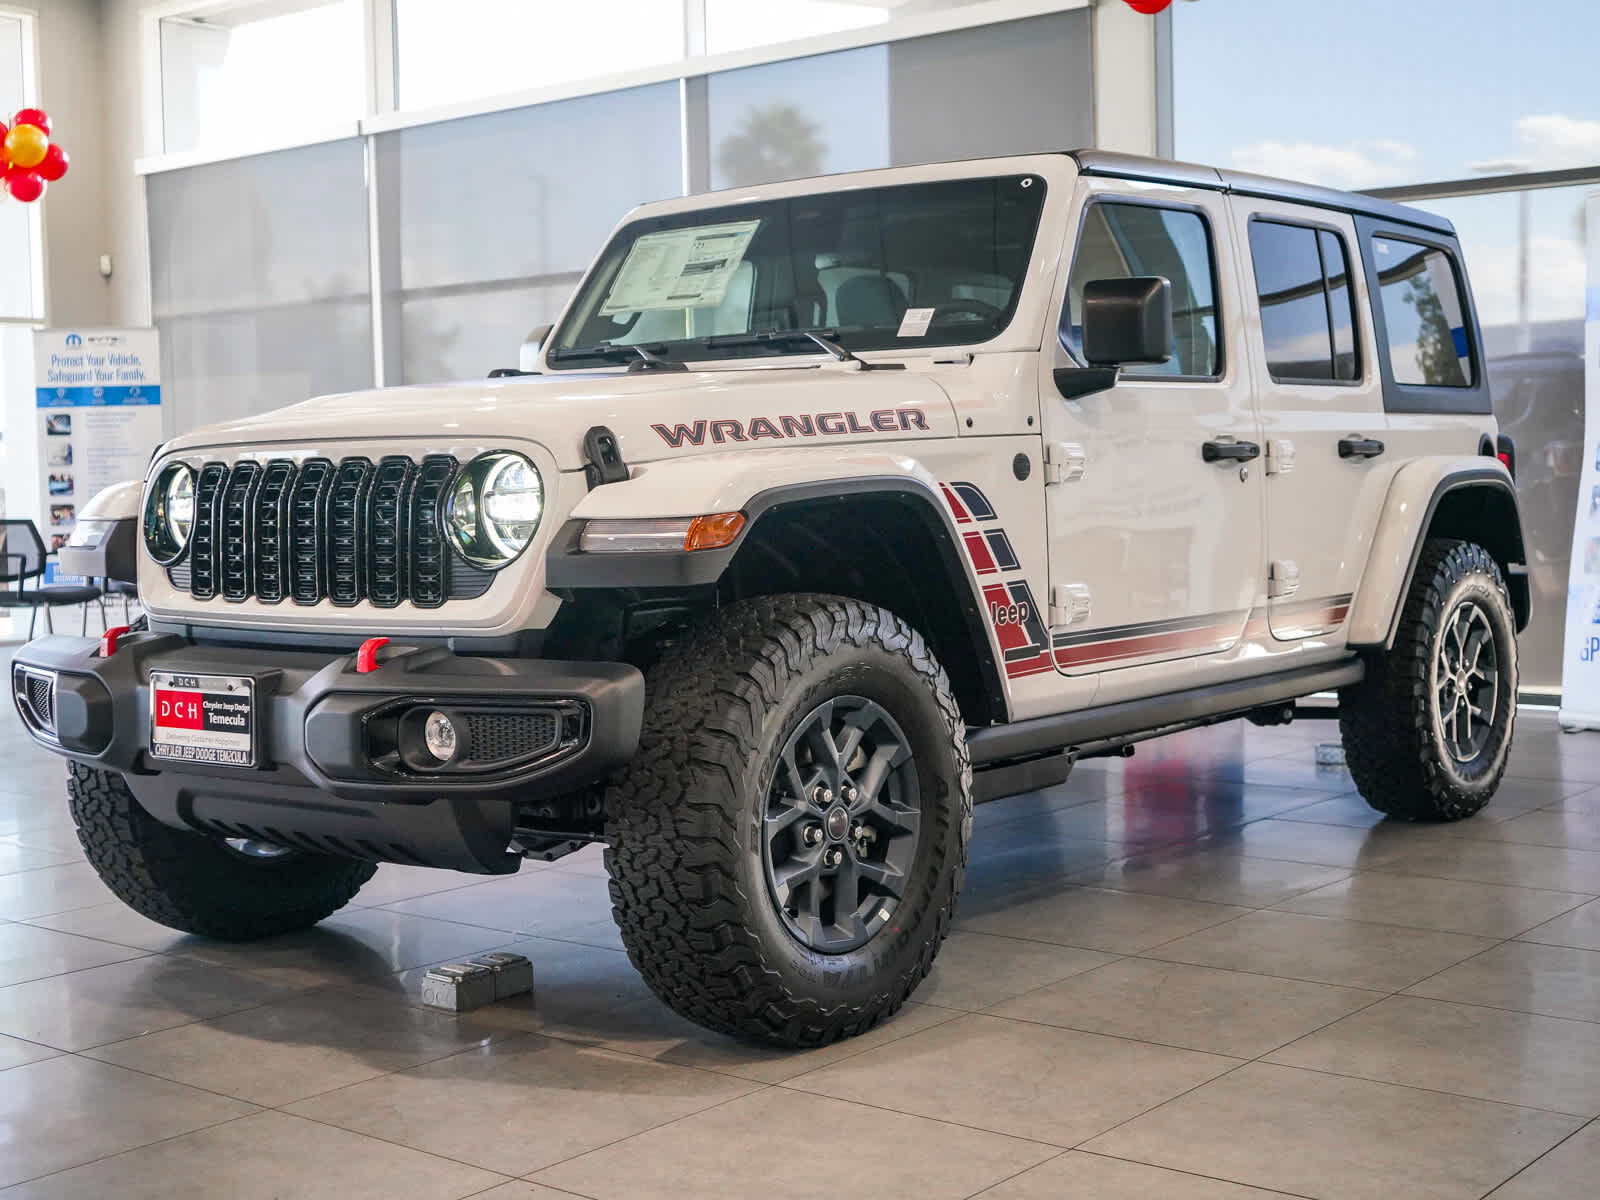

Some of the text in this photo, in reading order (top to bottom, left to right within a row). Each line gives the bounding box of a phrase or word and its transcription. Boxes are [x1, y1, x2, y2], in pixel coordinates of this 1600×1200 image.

[51, 354, 83, 368] Protect
[87, 353, 104, 366] Your
[48, 369, 92, 383] Safeguard
[95, 369, 113, 381] Your
[650, 408, 930, 448] WRANGLER
[991, 602, 1030, 626] Jeep
[202, 701, 250, 713] Chrysler Jeep Dodge
[208, 712, 246, 726] Temecula
[155, 743, 248, 764] CHRYSLER JEEP DODGE TEMECULA
